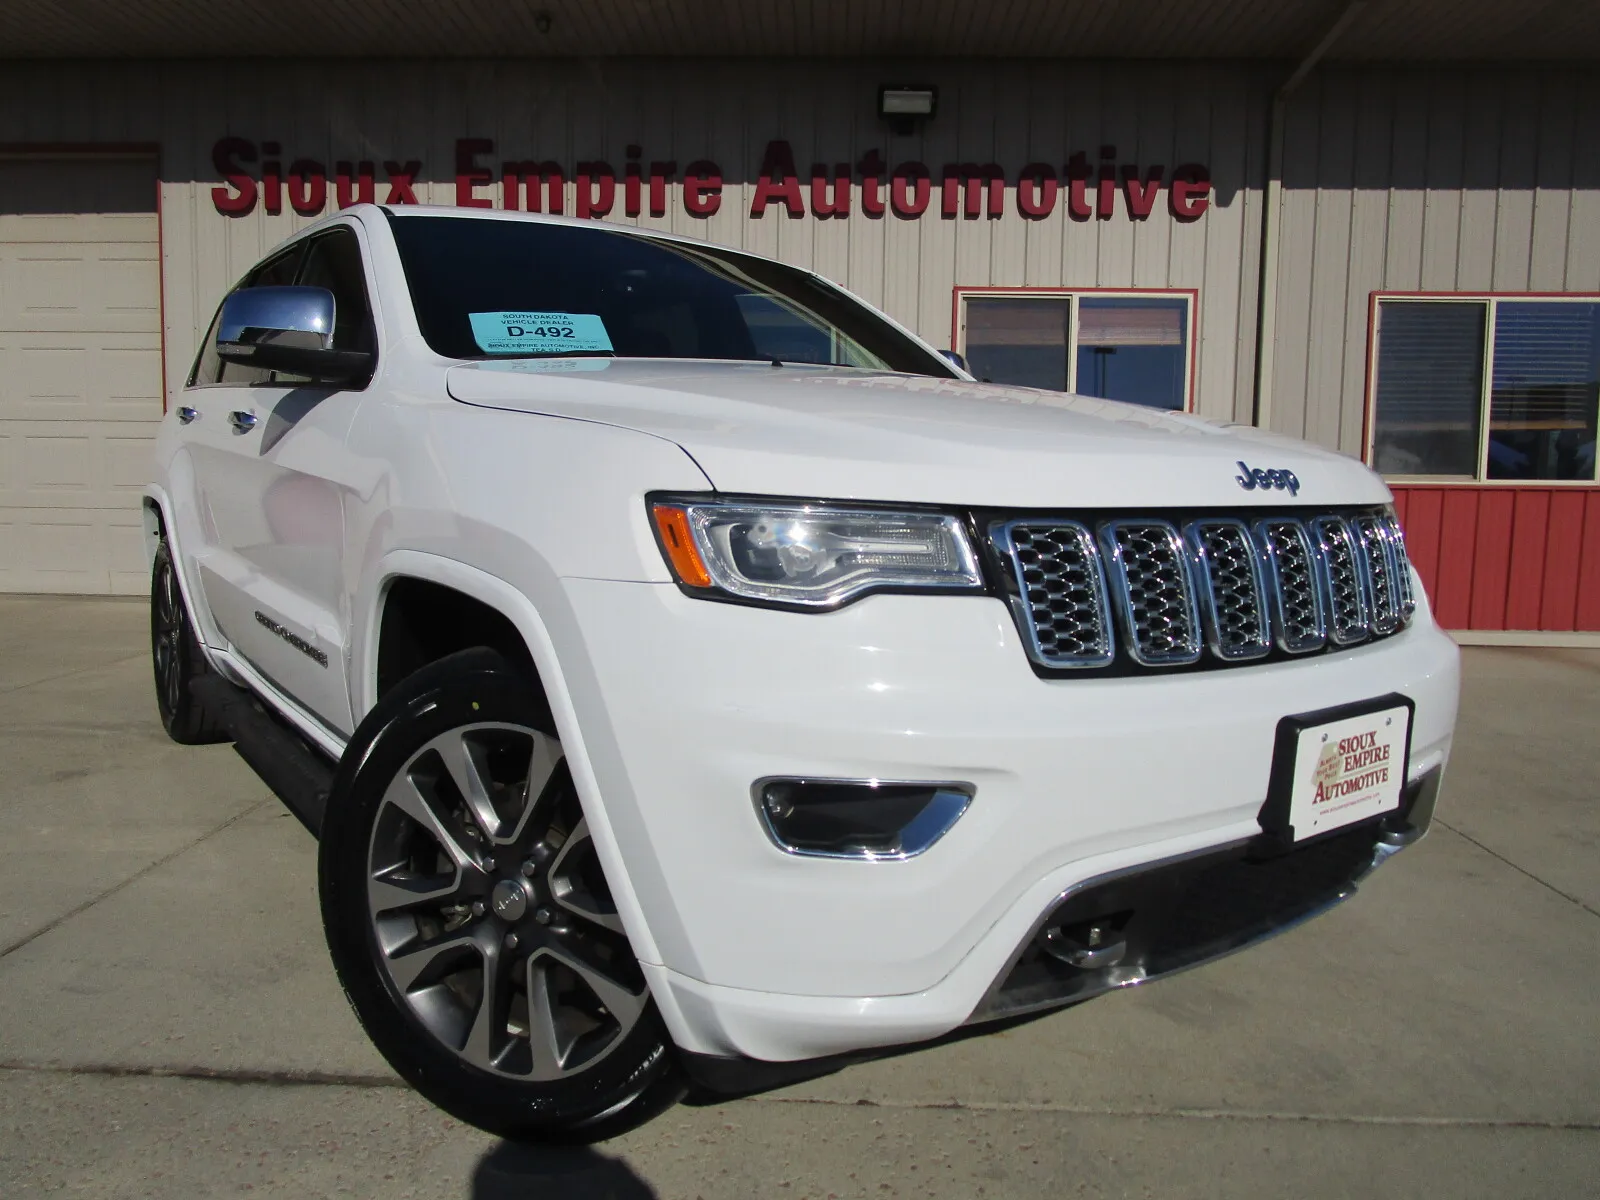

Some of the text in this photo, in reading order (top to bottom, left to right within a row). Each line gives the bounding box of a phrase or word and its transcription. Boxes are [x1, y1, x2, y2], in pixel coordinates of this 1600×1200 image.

[211, 136, 1212, 222] Sioux Empire Automotive
[506, 326, 576, 339] D-492
[1235, 460, 1300, 497] Jeep
[1338, 731, 1377, 757] SIOUX
[1344, 744, 1390, 773] EMPIRE
[1312, 768, 1389, 805] AUTOMOTIVE
